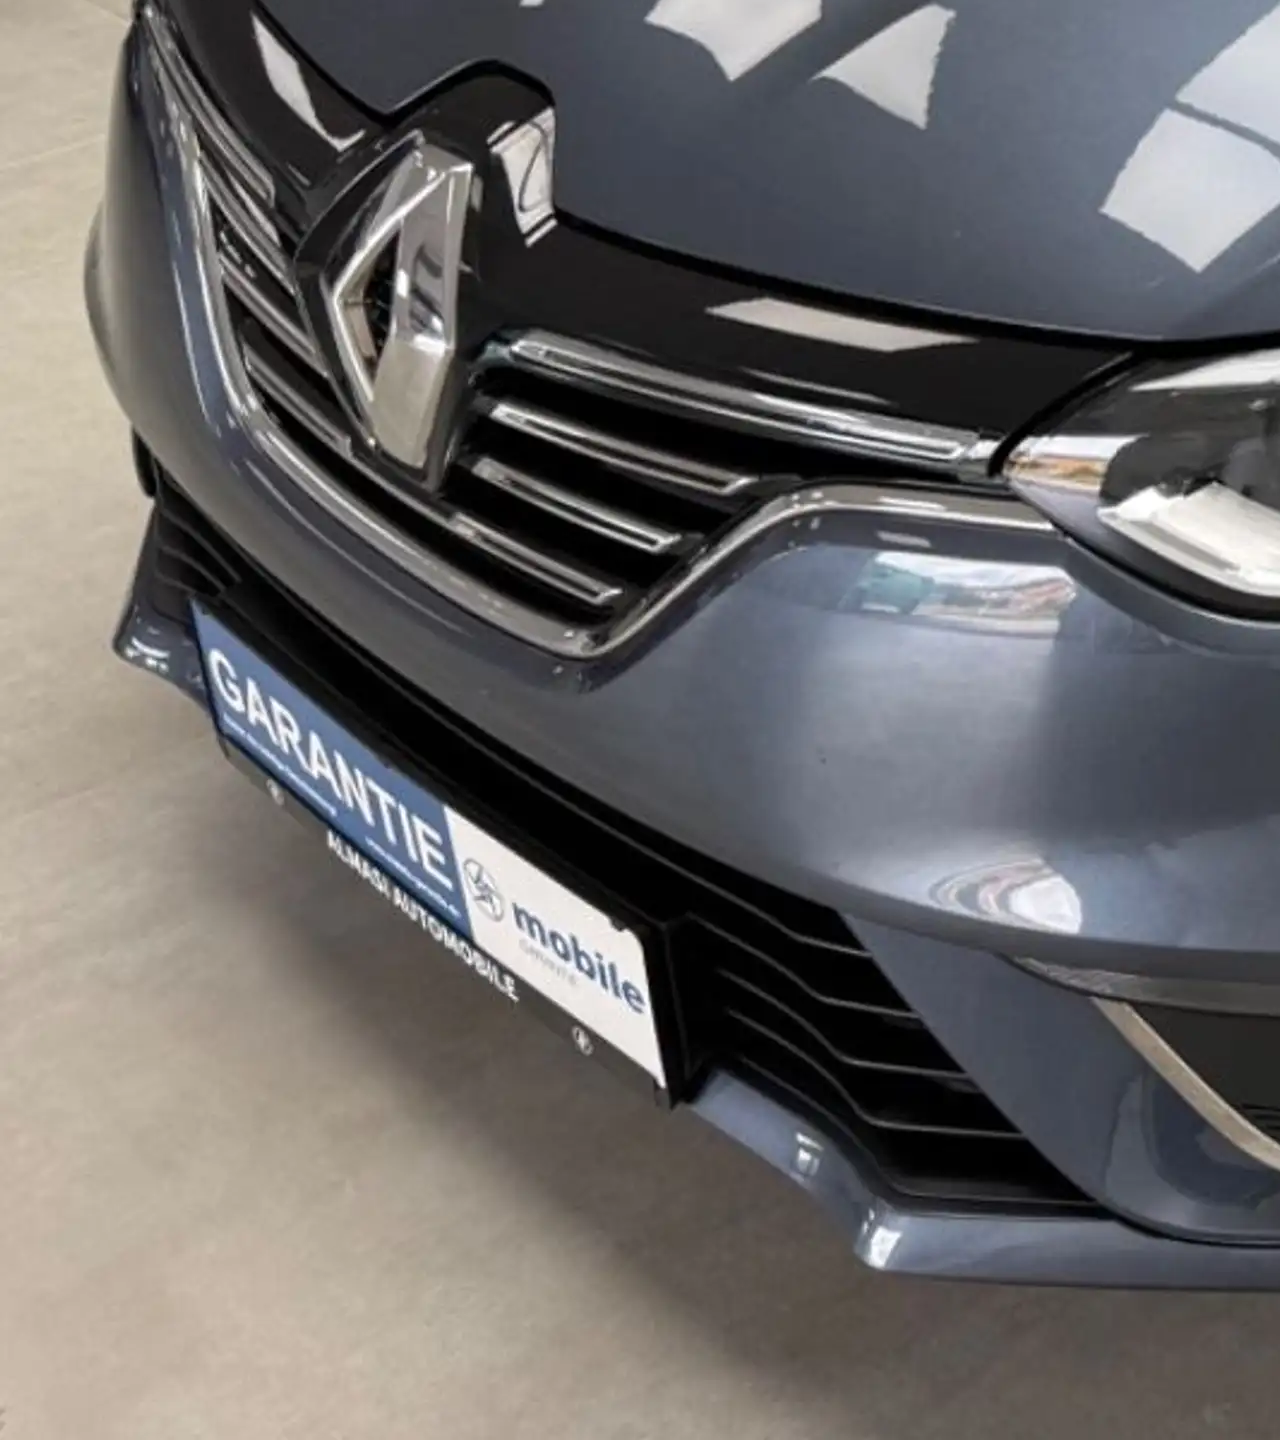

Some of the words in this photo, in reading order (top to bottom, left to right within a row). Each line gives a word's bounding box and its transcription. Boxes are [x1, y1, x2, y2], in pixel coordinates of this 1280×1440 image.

[206, 646, 455, 892] GARANTIE
[393, 887, 520, 1003] AUTOMOBILE
[512, 902, 646, 1014] mobile
